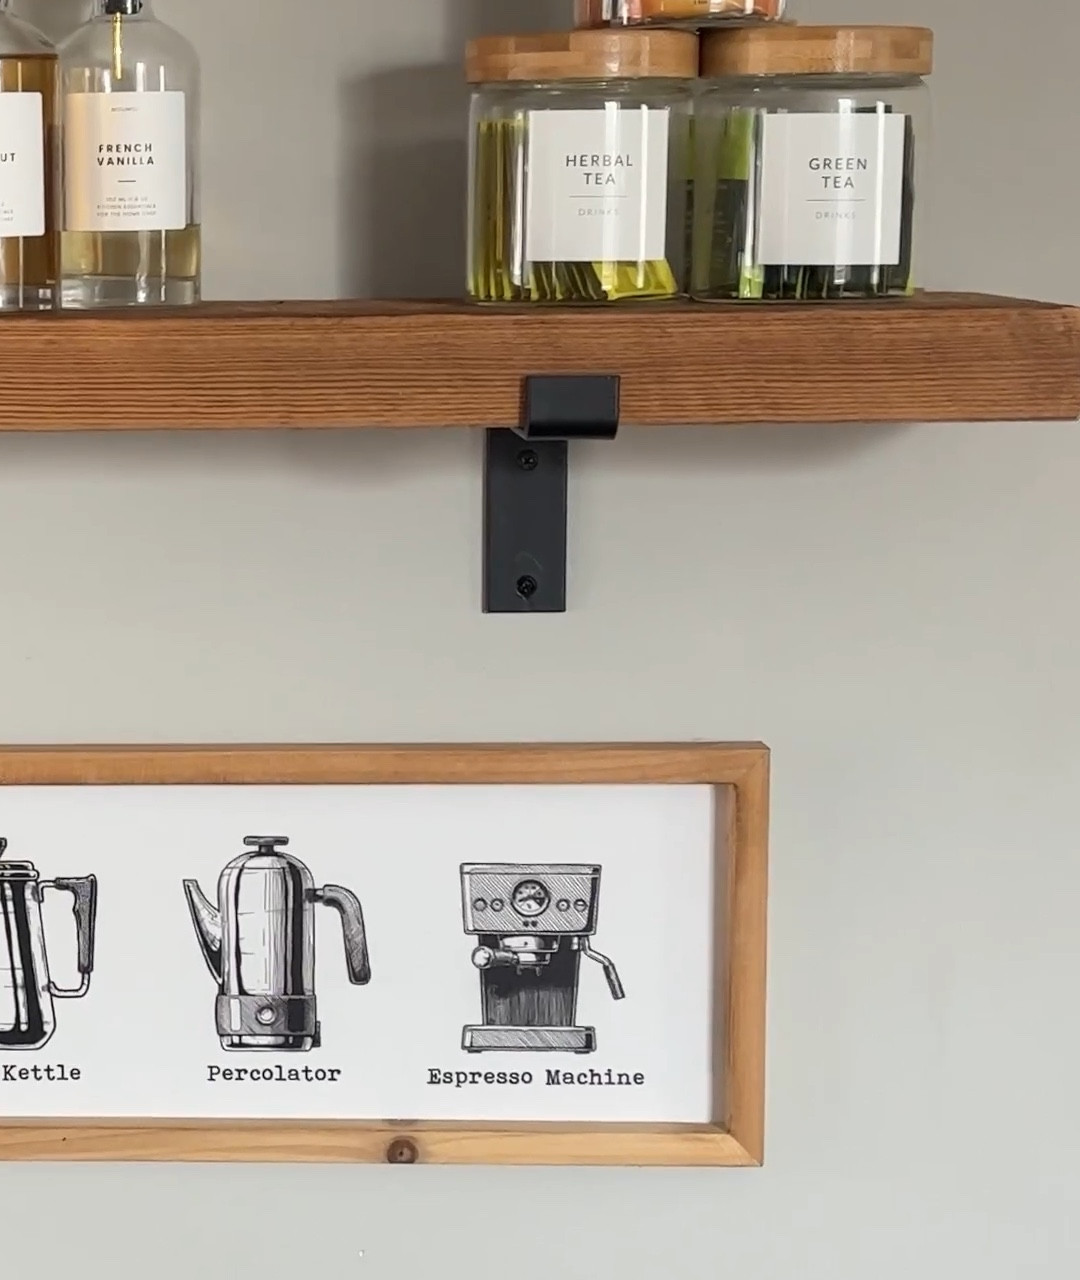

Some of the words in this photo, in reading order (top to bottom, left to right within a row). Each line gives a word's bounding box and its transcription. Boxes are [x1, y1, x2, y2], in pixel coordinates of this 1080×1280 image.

[98, 143, 153, 153] FRENCH
[97, 156, 155, 166] VANILLA
[565, 154, 633, 167] HERBAL
[808, 157, 868, 170] GREEN
[583, 172, 616, 185] TEA
[821, 176, 855, 189] TEA
[2, 1064, 81, 1081] Kettle
[206, 1065, 342, 1082] Percolator
[426, 1068, 533, 1088] Espresso
[545, 1068, 645, 1086] Machine
